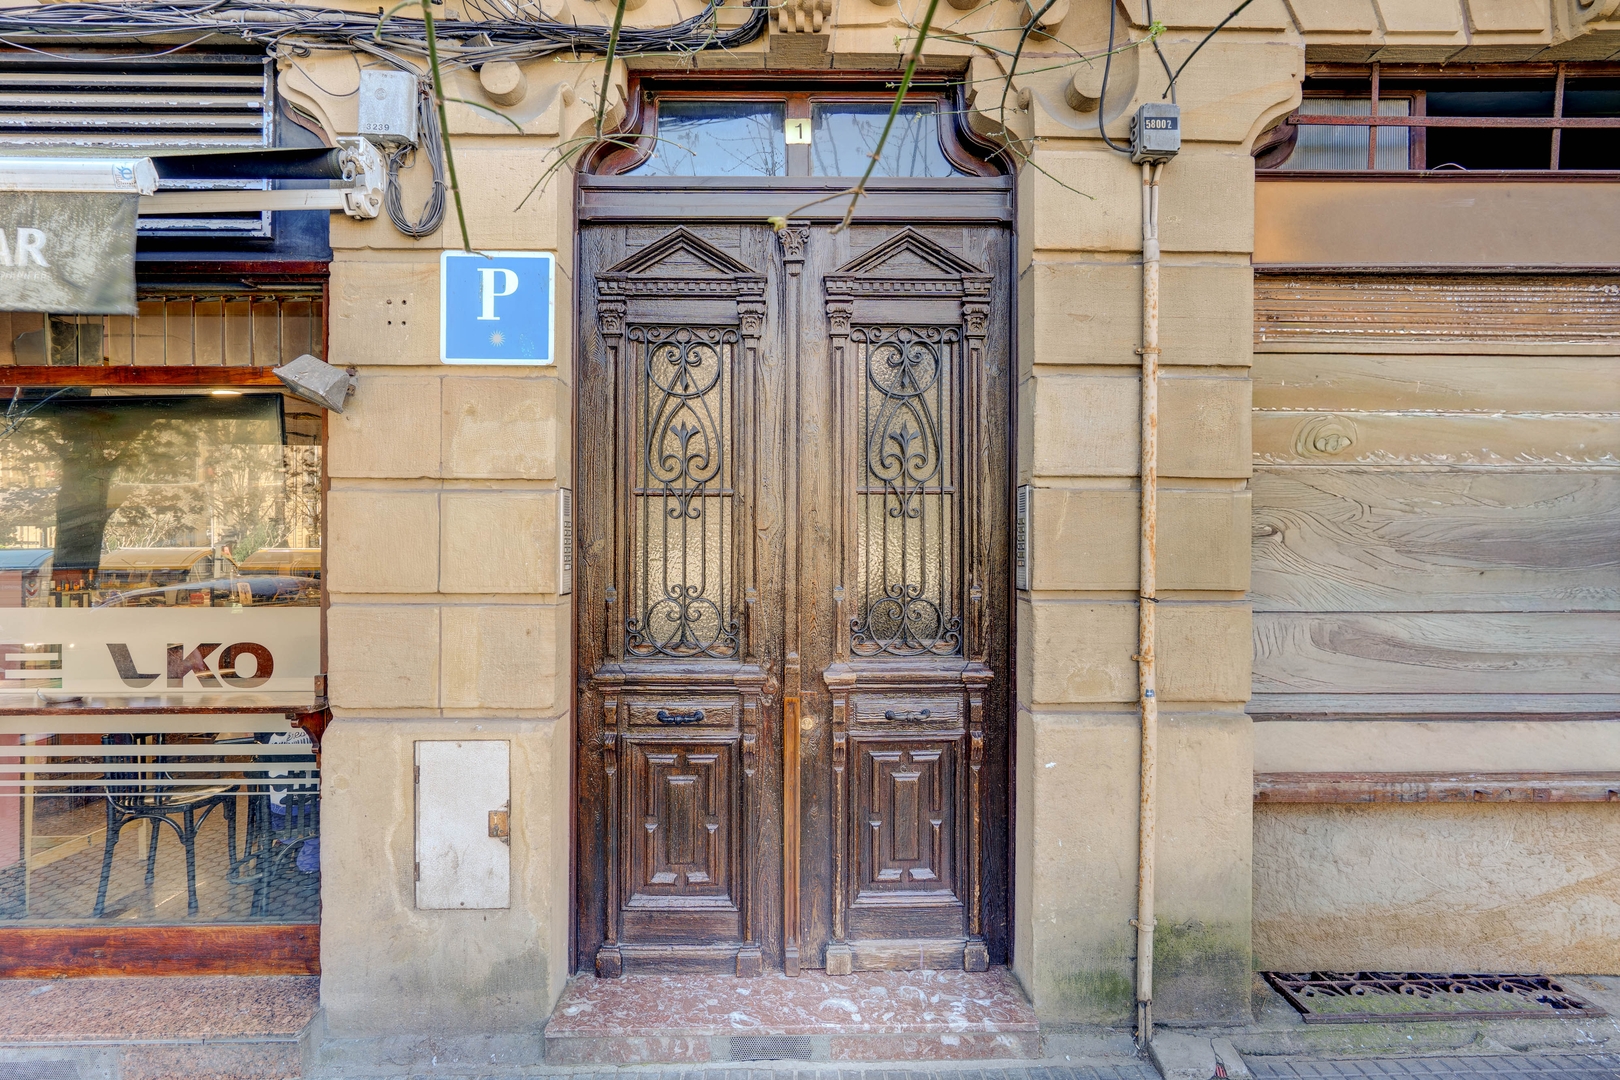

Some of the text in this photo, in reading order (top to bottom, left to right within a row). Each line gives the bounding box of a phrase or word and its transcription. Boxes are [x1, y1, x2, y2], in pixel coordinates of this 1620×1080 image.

[366, 123, 390, 131] 3239
[1145, 119, 1172, 129] 58002
[795, 123, 802, 139] 1
[477, 268, 519, 320] P
